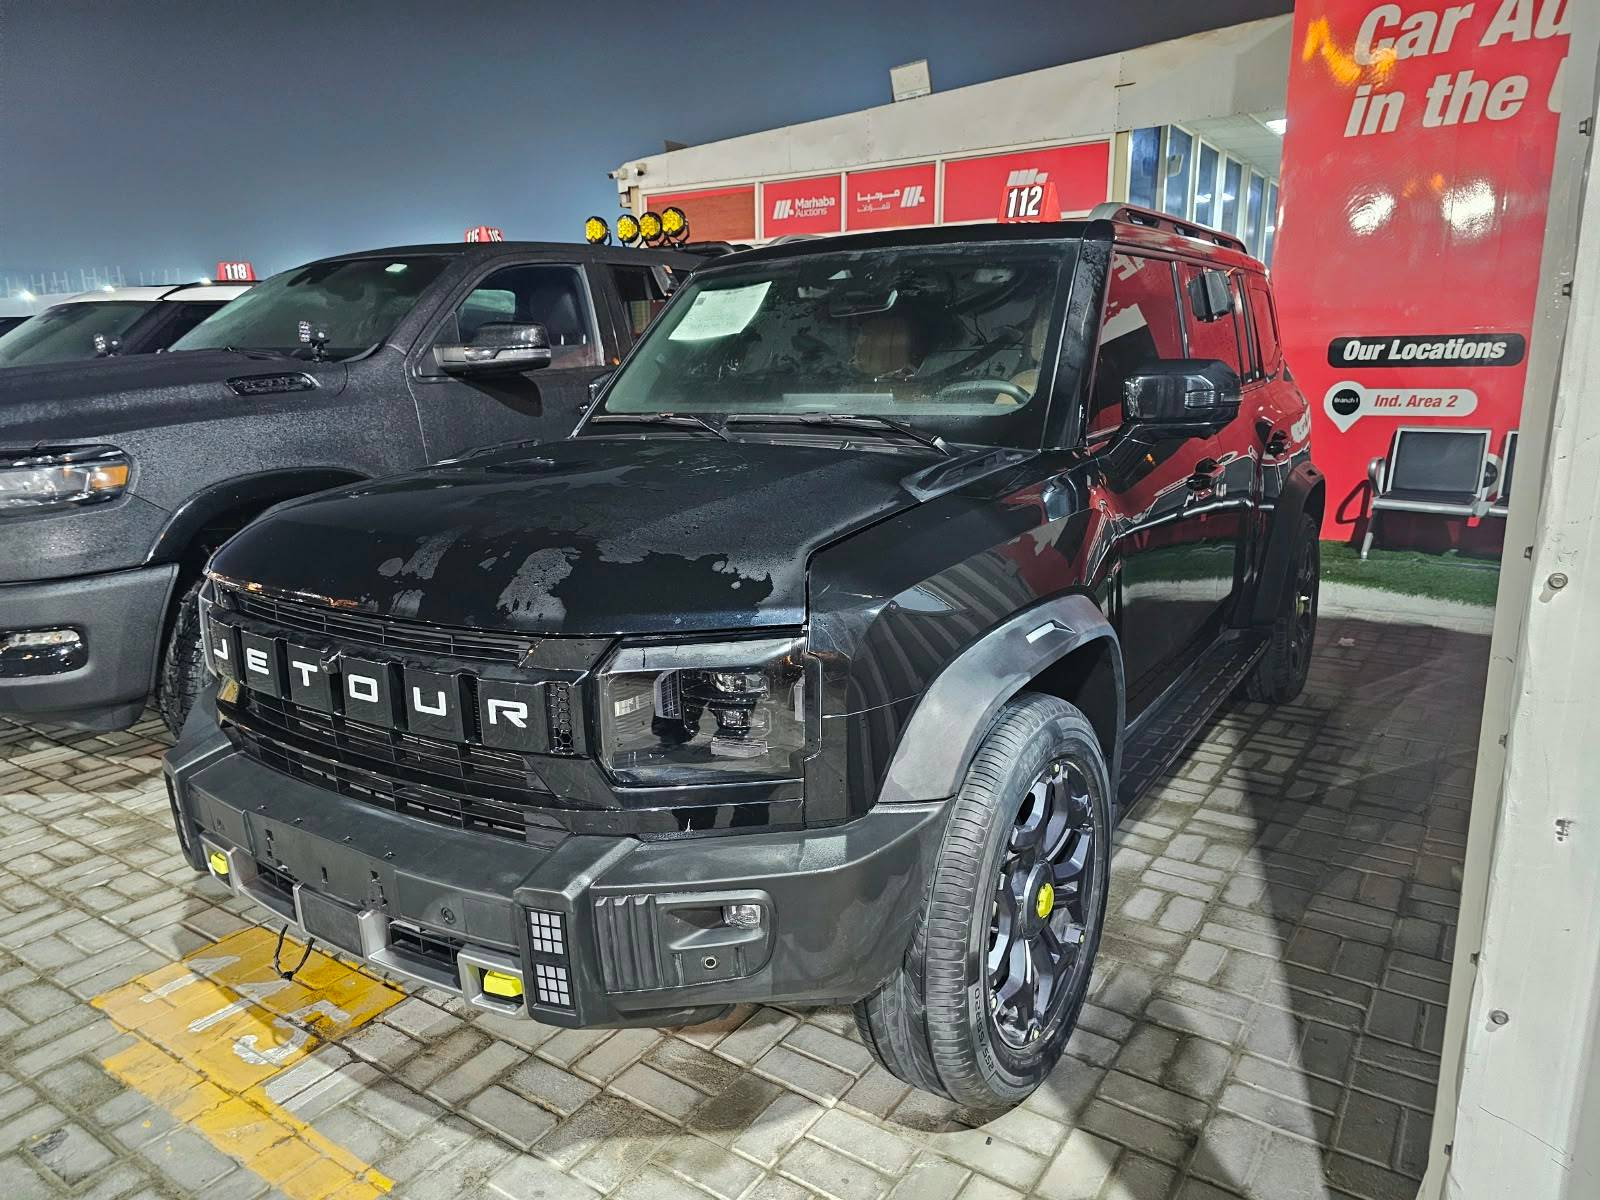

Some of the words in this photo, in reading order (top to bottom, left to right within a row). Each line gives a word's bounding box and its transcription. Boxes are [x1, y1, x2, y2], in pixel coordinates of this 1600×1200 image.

[1354, 2, 1475, 65] Car
[1479, 0, 1571, 47] Au
[1344, 84, 1405, 137] in
[1422, 69, 1528, 128] the
[795, 195, 835, 209] Marhaba
[857, 189, 900, 203] مرحبا
[1007, 185, 1043, 218] 112
[794, 207, 828, 218] Auctions
[225, 263, 247, 280] 118
[1343, 340, 1386, 361] Our
[1388, 338, 1507, 360] Locations
[1374, 395, 1402, 407] Ind.
[1406, 395, 1442, 407] Area
[1446, 395, 1458, 407] 2
[213, 638, 529, 730] JETOUR
